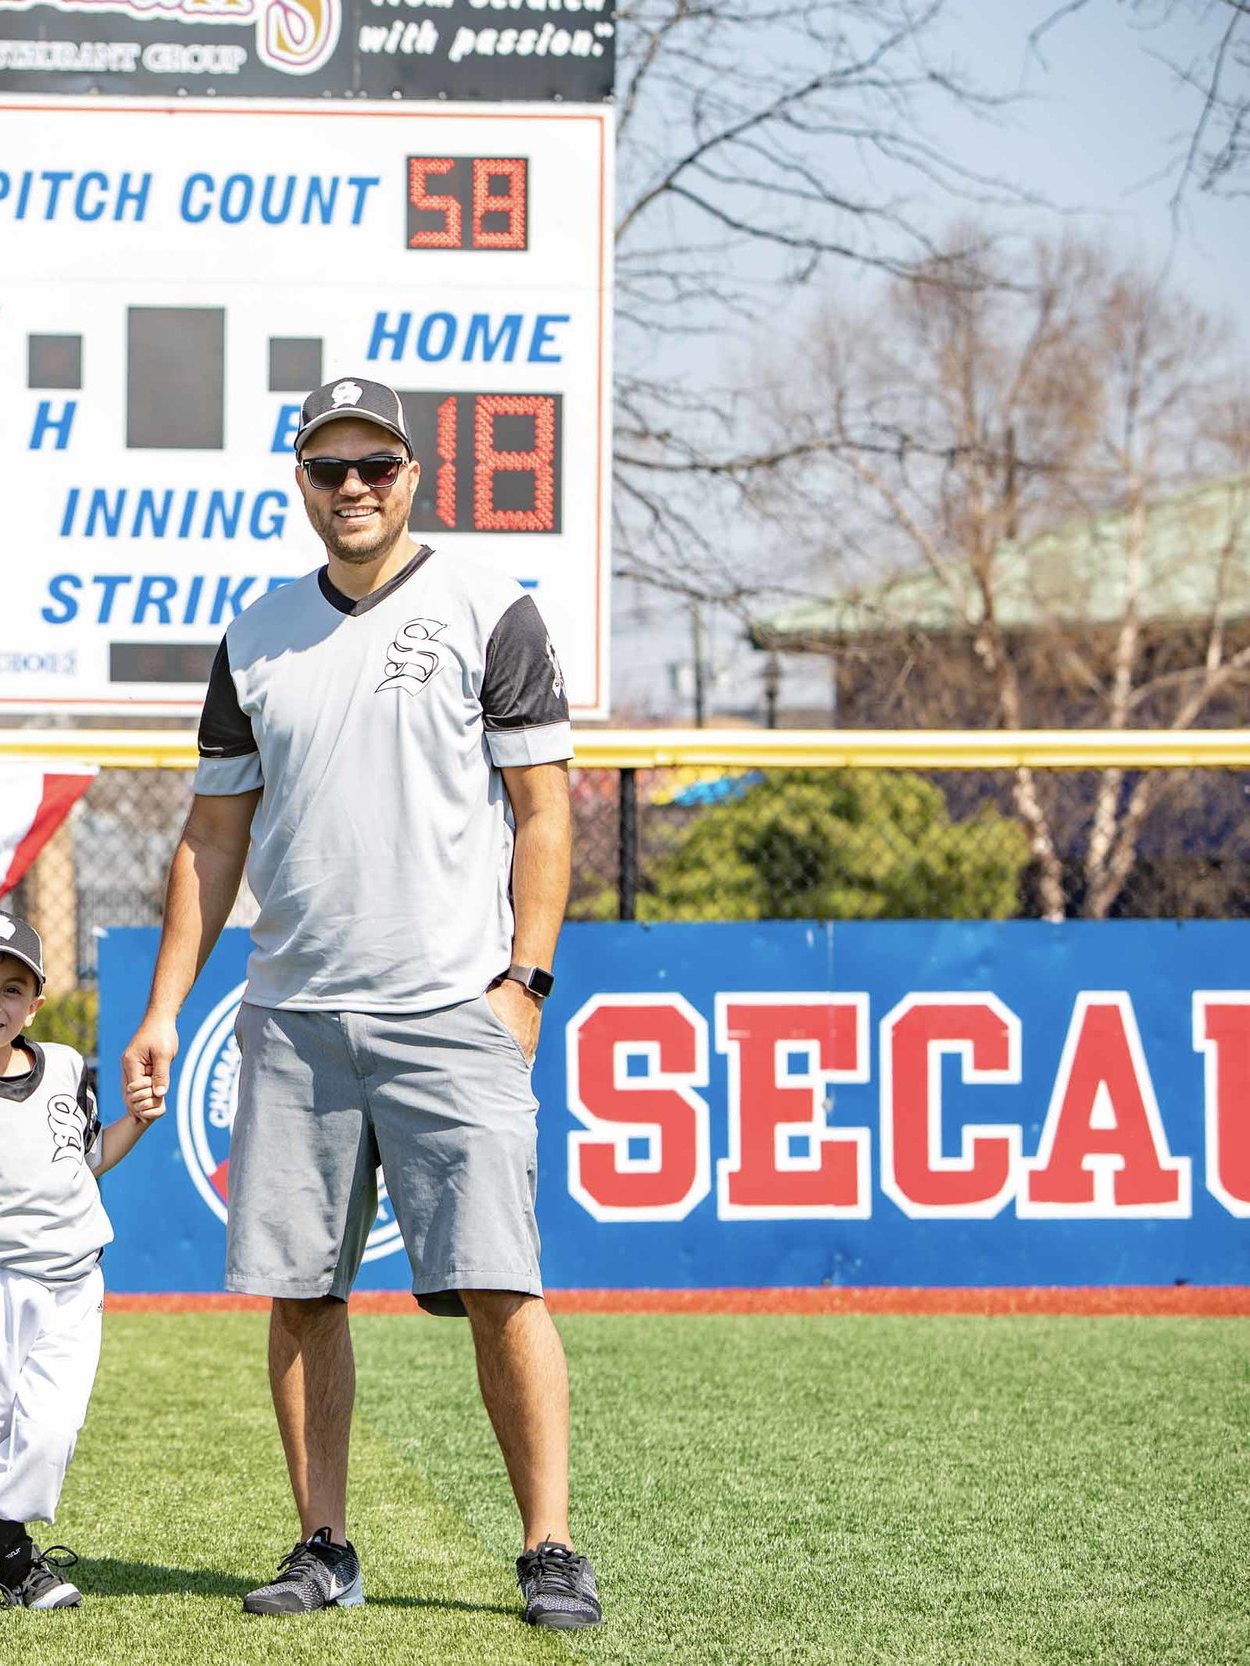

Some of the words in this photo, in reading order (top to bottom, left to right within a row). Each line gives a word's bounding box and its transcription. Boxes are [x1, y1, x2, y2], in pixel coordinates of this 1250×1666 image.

[142, 43, 247, 74] GROUP
[359, 20, 438, 54] with
[180, 172, 380, 224] COUNT
[410, 158, 526, 248] 58
[366, 311, 570, 363] HOME
[29, 401, 77, 450] H
[437, 395, 554, 531] 18
[61, 488, 288, 540] INNING
[374, 617, 448, 697] S
